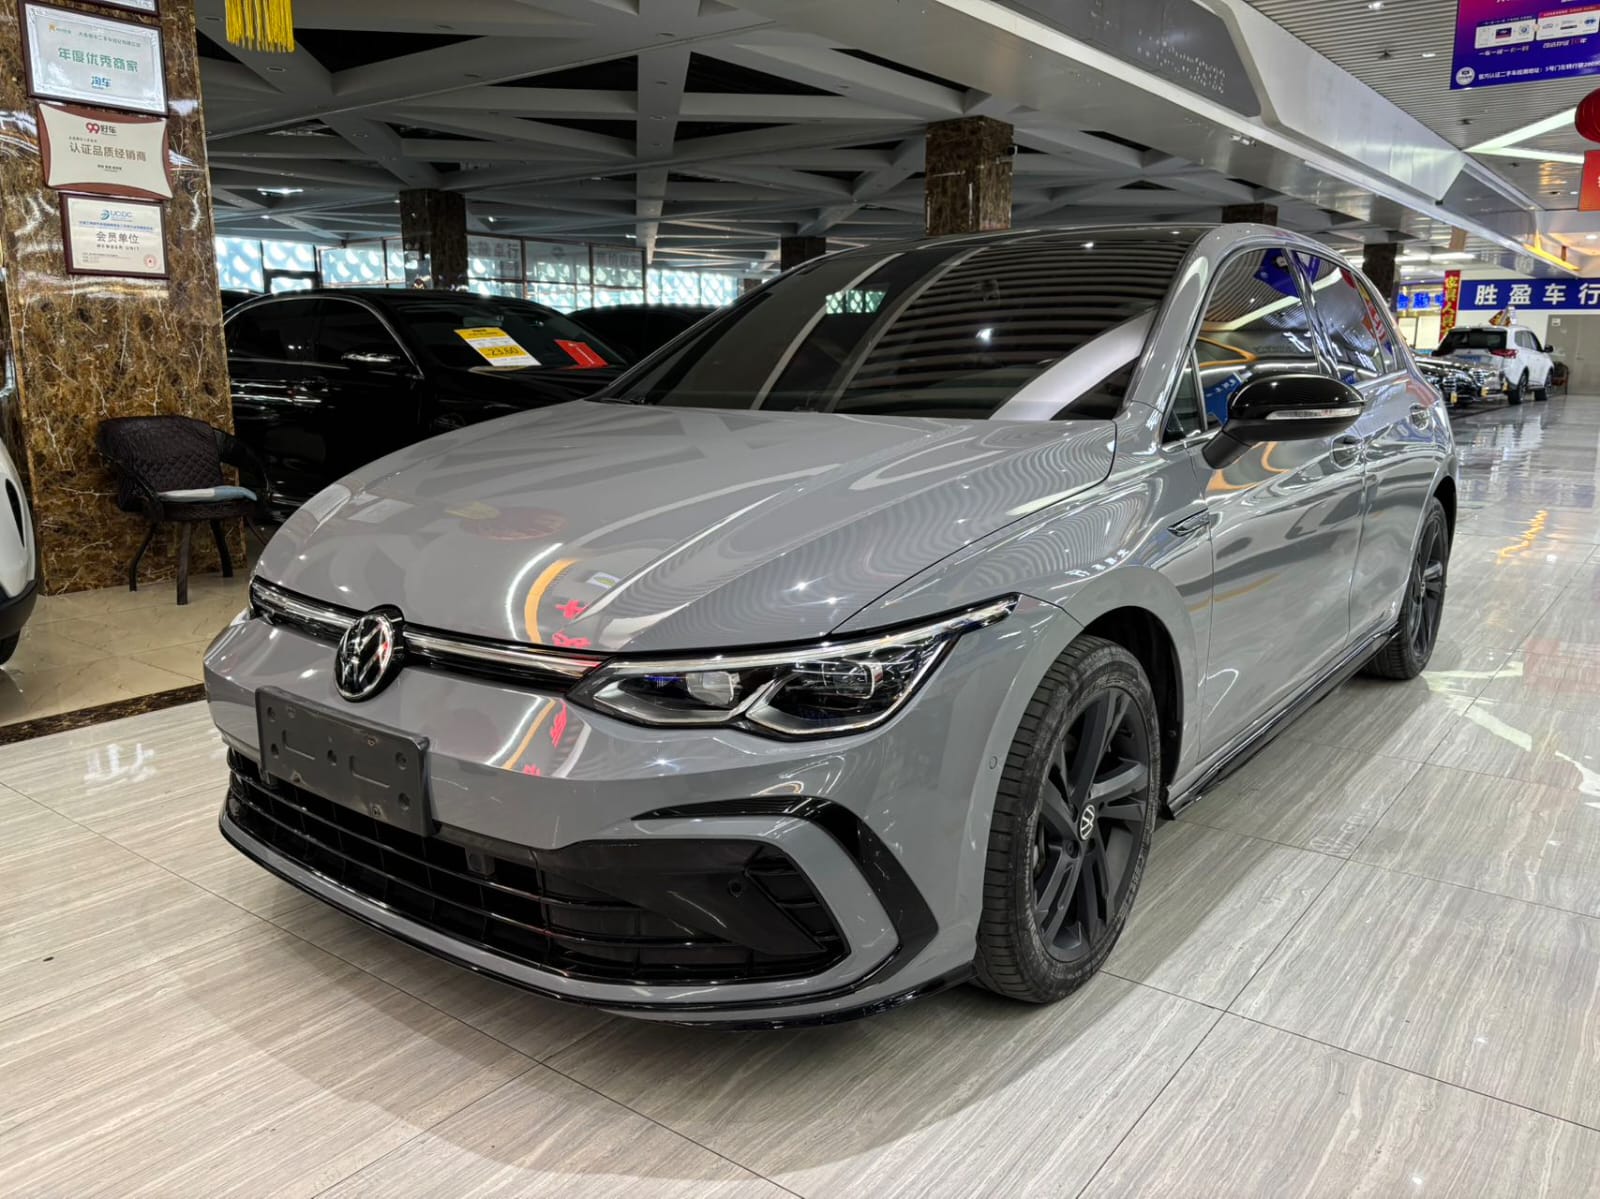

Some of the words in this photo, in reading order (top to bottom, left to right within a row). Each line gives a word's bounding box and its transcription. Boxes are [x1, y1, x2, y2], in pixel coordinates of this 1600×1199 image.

[58, 47, 138, 73] 年度优秀商家
[69, 142, 146, 162] 认证品质经销商
[96, 231, 140, 245] 会员单位
[1474, 283, 1600, 306] 胜盈车行
